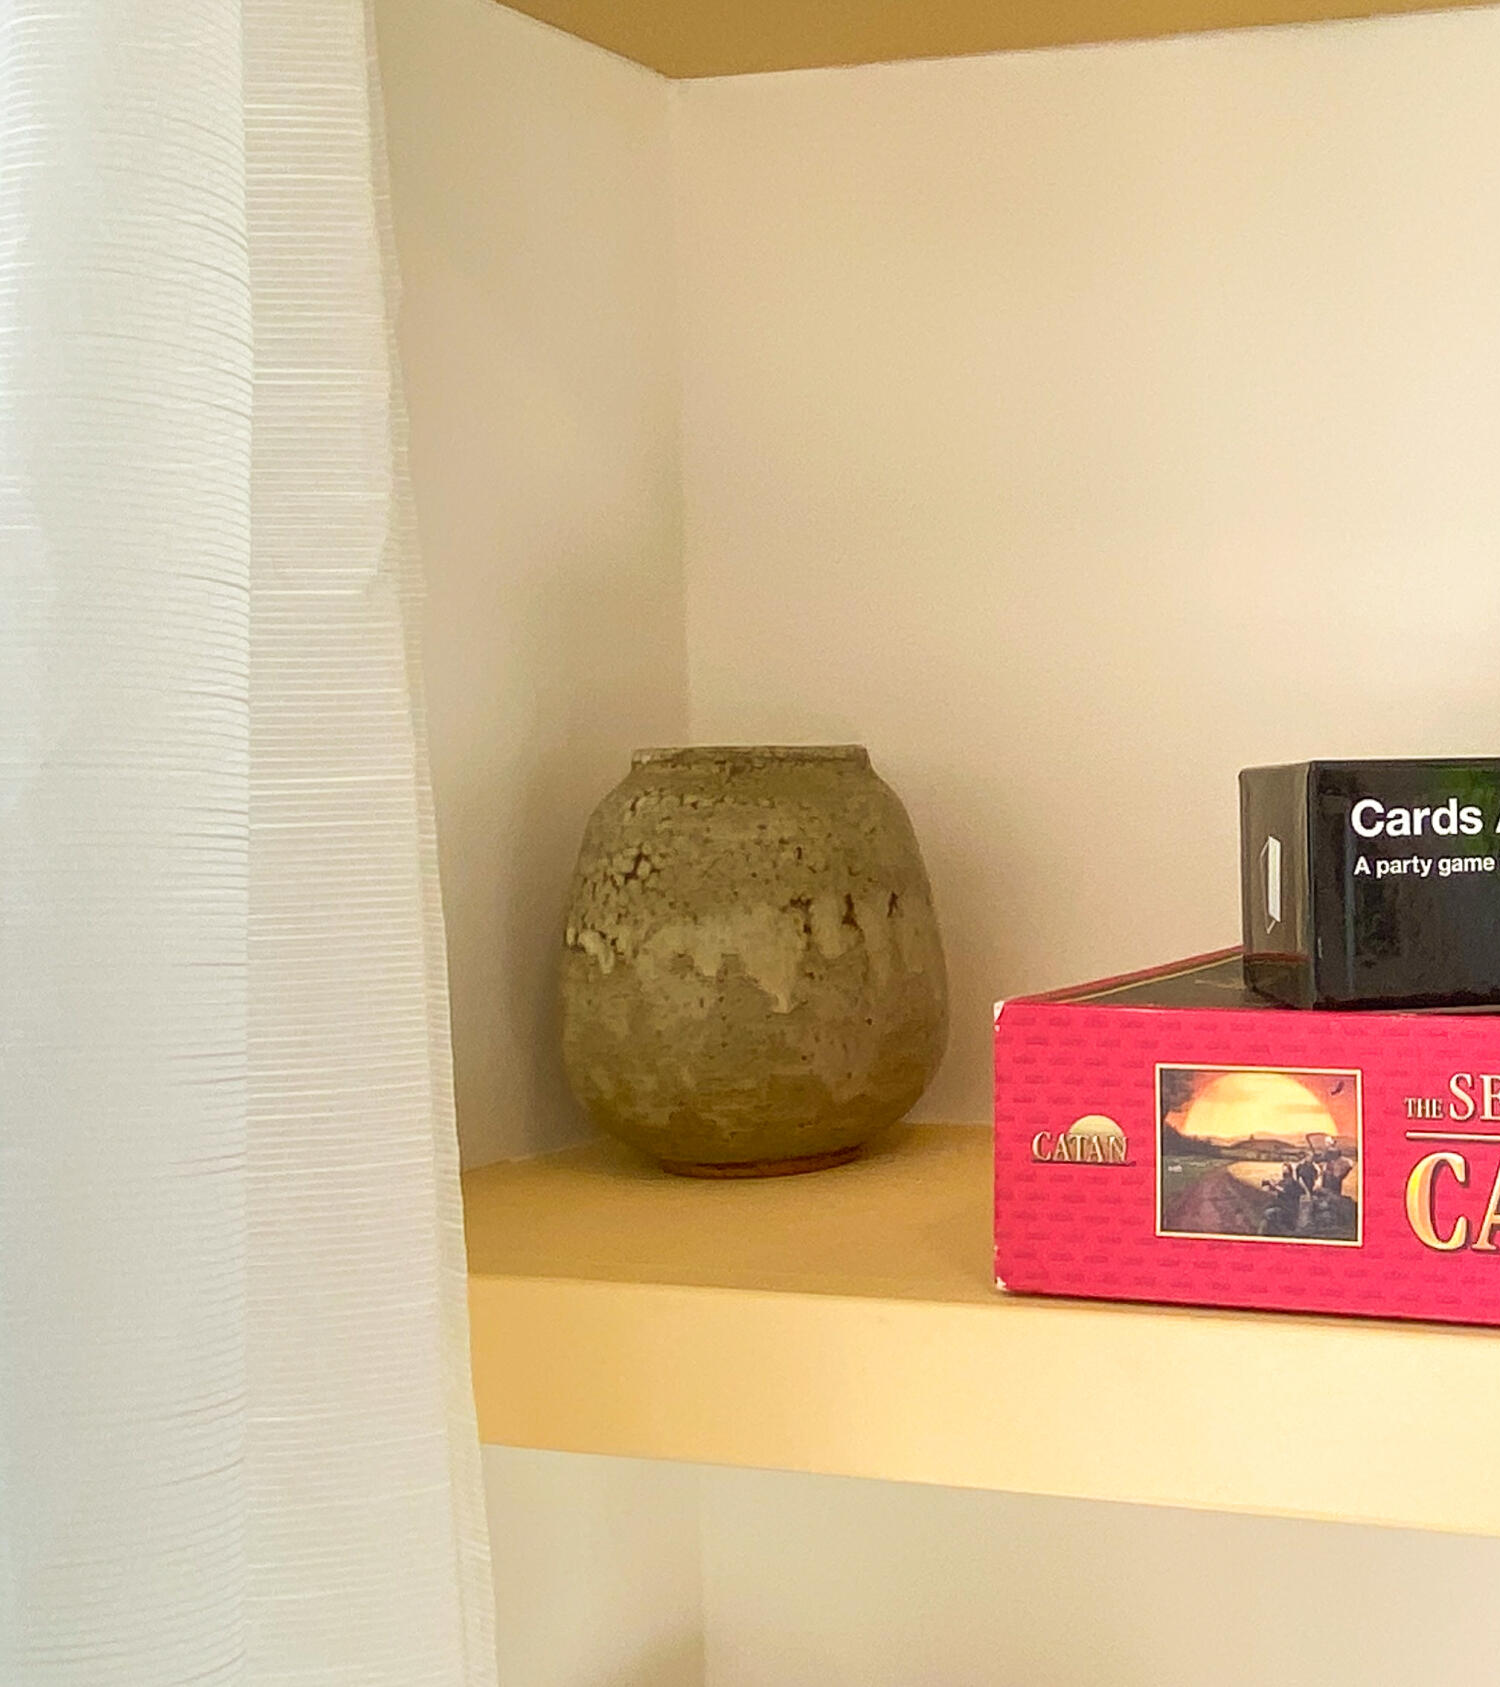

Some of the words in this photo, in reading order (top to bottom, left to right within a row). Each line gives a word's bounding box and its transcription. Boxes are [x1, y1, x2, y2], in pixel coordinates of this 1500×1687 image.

[1351, 797, 1483, 838] Cards
[1354, 856, 1371, 875] A
[1376, 855, 1432, 878] party
[1438, 855, 1496, 877] game
[1404, 1097, 1443, 1118] THE
[1032, 1131, 1129, 1163] CATAN
